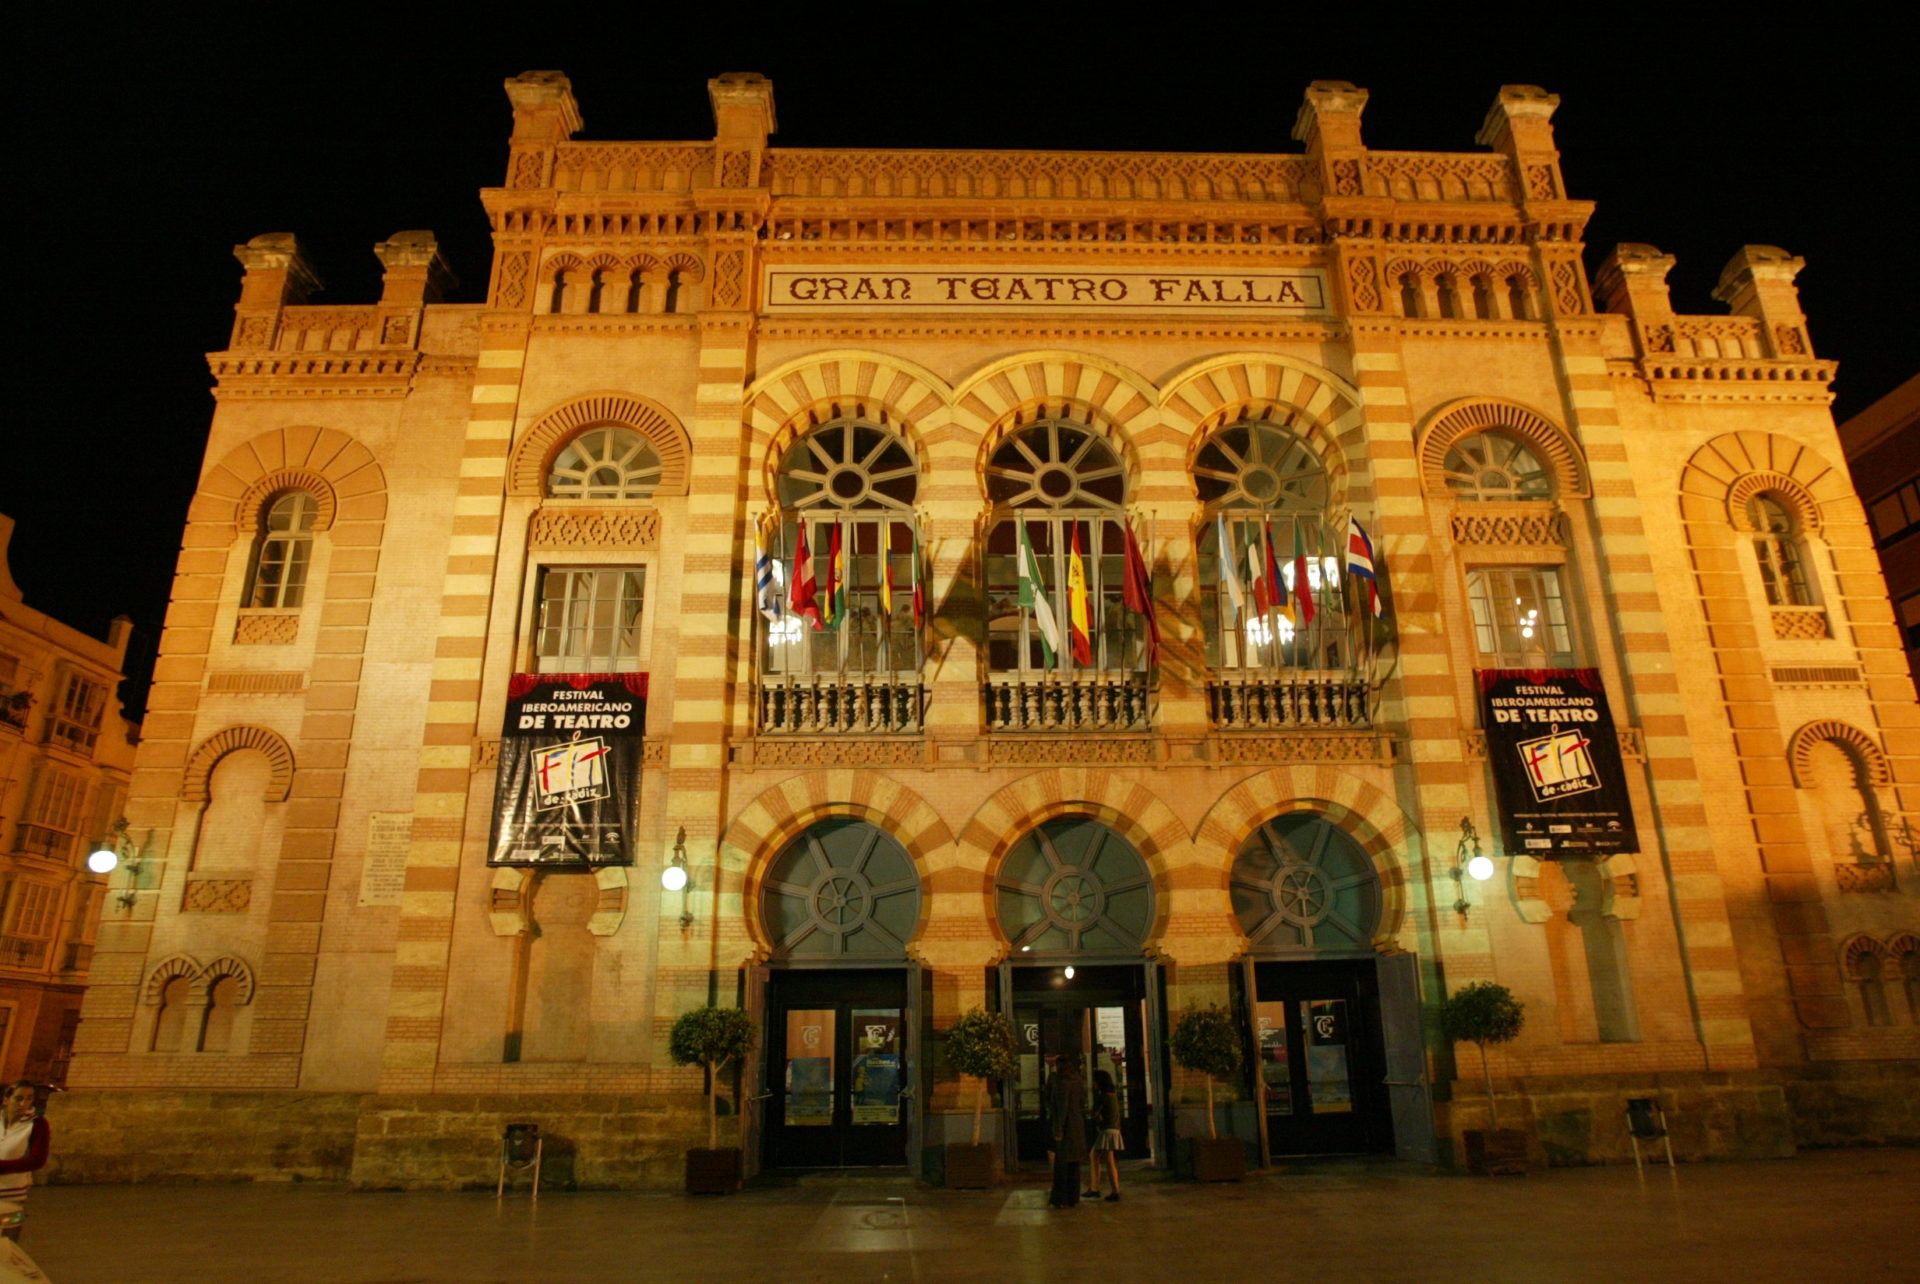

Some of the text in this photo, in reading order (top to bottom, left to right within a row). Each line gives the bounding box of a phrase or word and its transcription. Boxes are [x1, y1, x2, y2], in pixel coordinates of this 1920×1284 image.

[789, 277, 1304, 303] GRAN TEATRO FALLA
[553, 690, 604, 700] FESTIVAL
[1515, 686, 1564, 695] FESTIVAL
[522, 703, 632, 713] IBEROAMERICANO
[1492, 698, 1594, 707] IBEROAMERICANO
[519, 714, 631, 729] DE TEATRO
[1494, 709, 1599, 723] DE TEATRO
[1541, 785, 1556, 796] de
[544, 795, 559, 806] de
